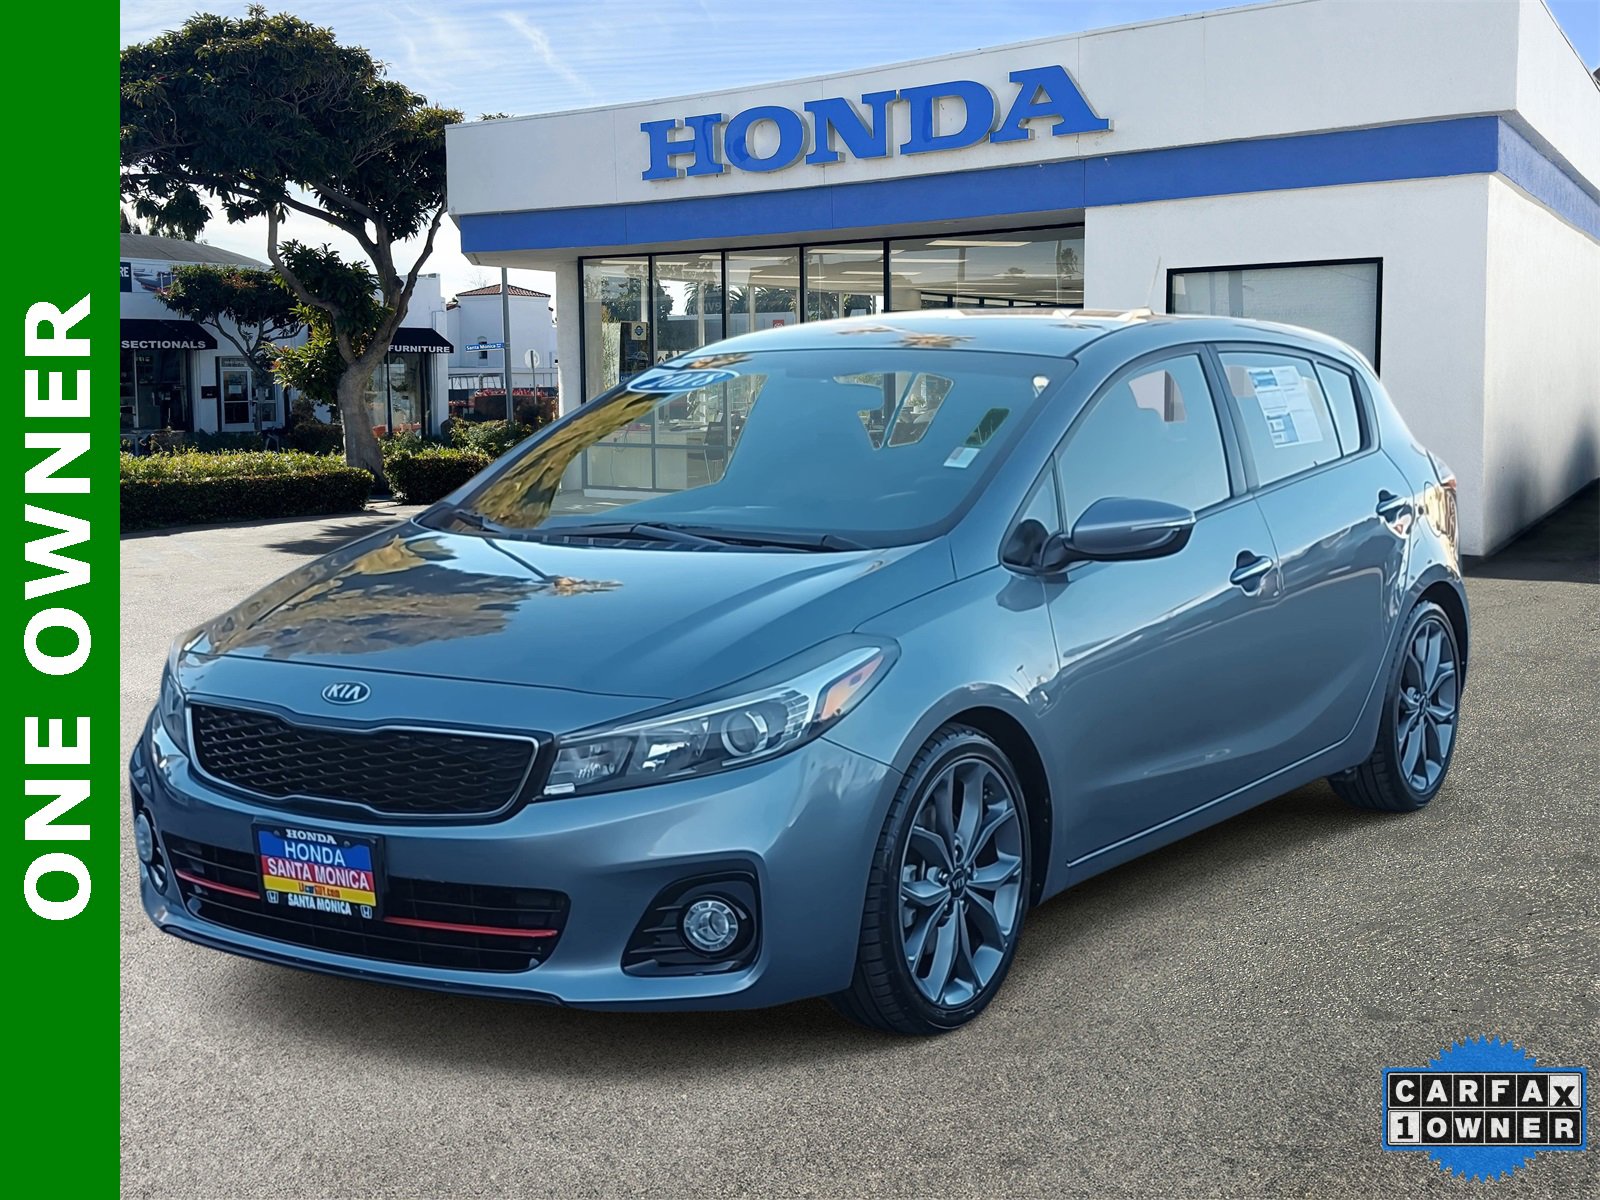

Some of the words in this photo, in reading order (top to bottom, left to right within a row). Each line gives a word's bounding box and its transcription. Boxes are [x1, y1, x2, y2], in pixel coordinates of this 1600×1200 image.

[640, 65, 1113, 182] HONDA
[121, 340, 206, 349] SECTIONALS
[388, 344, 450, 353] FURNITURE
[327, 684, 361, 700] KIA
[285, 828, 337, 845] HONDA
[284, 840, 346, 867] HONDA
[267, 857, 313, 881] SANTA
[314, 865, 370, 890] MONICA
[288, 893, 316, 910] SANTA
[316, 898, 352, 916] MONICA
